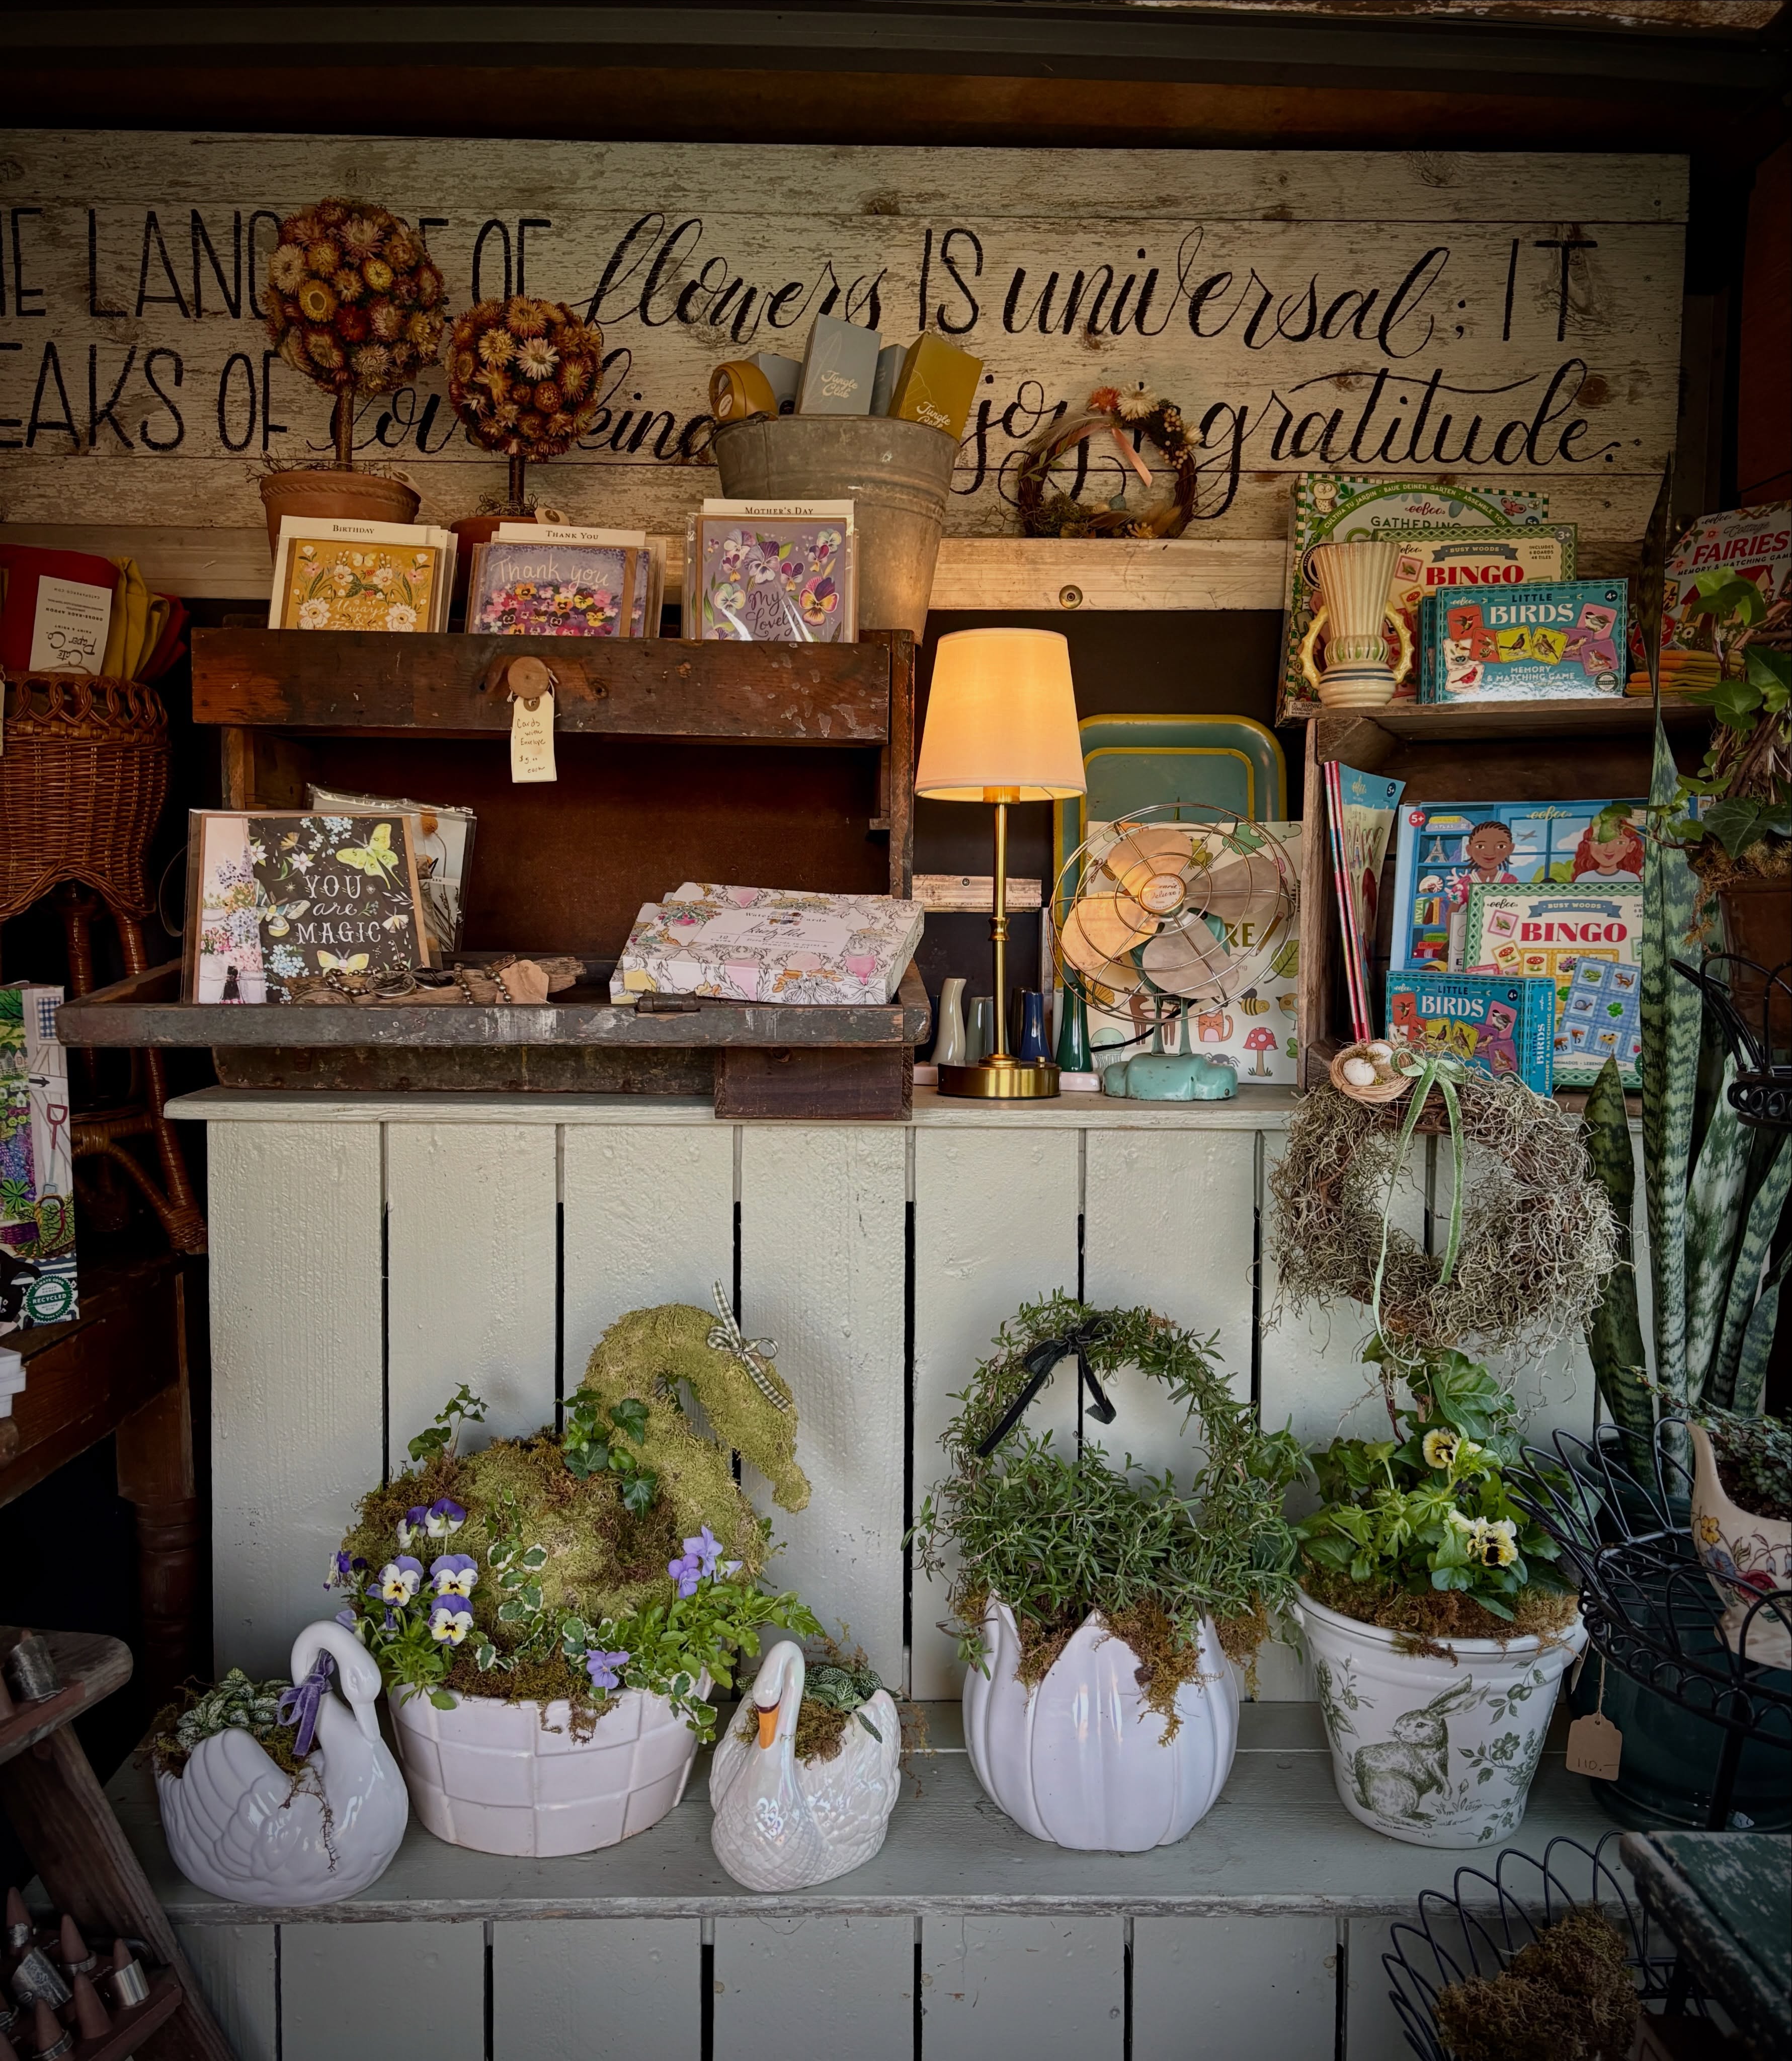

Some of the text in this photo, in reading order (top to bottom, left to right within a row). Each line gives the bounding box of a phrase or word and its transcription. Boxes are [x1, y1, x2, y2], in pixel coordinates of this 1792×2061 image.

[0, 208, 46, 317] E
[471, 218, 551, 304] OF
[571, 212, 887, 347] flowers
[919, 228, 984, 334] IS
[1503, 237, 1598, 341] IT
[821, 370, 858, 389] Jungle
[823, 383, 850, 398] Club
[217, 351, 288, 451] OF
[916, 401, 951, 426] Jungle
[745, 507, 792, 515] MOTHER'S
[1324, 509, 1346, 529] CULTIVA
[1346, 501, 1355, 510] TU
[1356, 491, 1377, 506] JARDIN
[1383, 485, 1401, 493] BAUE
[1430, 485, 1457, 496] GARTEN
[1462, 495, 1495, 515] ASSEMBLE
[546, 530, 577, 539] THANK
[1558, 531, 1571, 540] 3+
[1692, 530, 1790, 566] FAIRIES
[491, 554, 609, 592] Thank you
[1426, 565, 1525, 586] BINGO
[1677, 566, 1712, 576] MEMORY
[1512, 593, 1553, 603] LITTLE
[1606, 592, 1617, 600] 4+
[330, 599, 388, 619] Always
[1490, 603, 1575, 624] BIRDS
[354, 613, 364, 625] &
[1496, 673, 1546, 681] MATCHING
[517, 718, 540, 729] Cards
[1387, 786, 1395, 794] 5+
[1411, 814, 1424, 823] 5+
[302, 875, 362, 899] YOU
[312, 902, 358, 916] are
[746, 912, 797, 920] Watercolor
[1415, 901, 1423, 924] ITALY
[295, 921, 382, 944] MAGIC
[1520, 922, 1627, 942] BINGO
[1438, 985, 1469, 995] LITTLE
[1421, 995, 1484, 1017] BIRDS
[1536, 1023, 1545, 1065] BIRDS
[32, 1294, 67, 1304] RECYCLED
